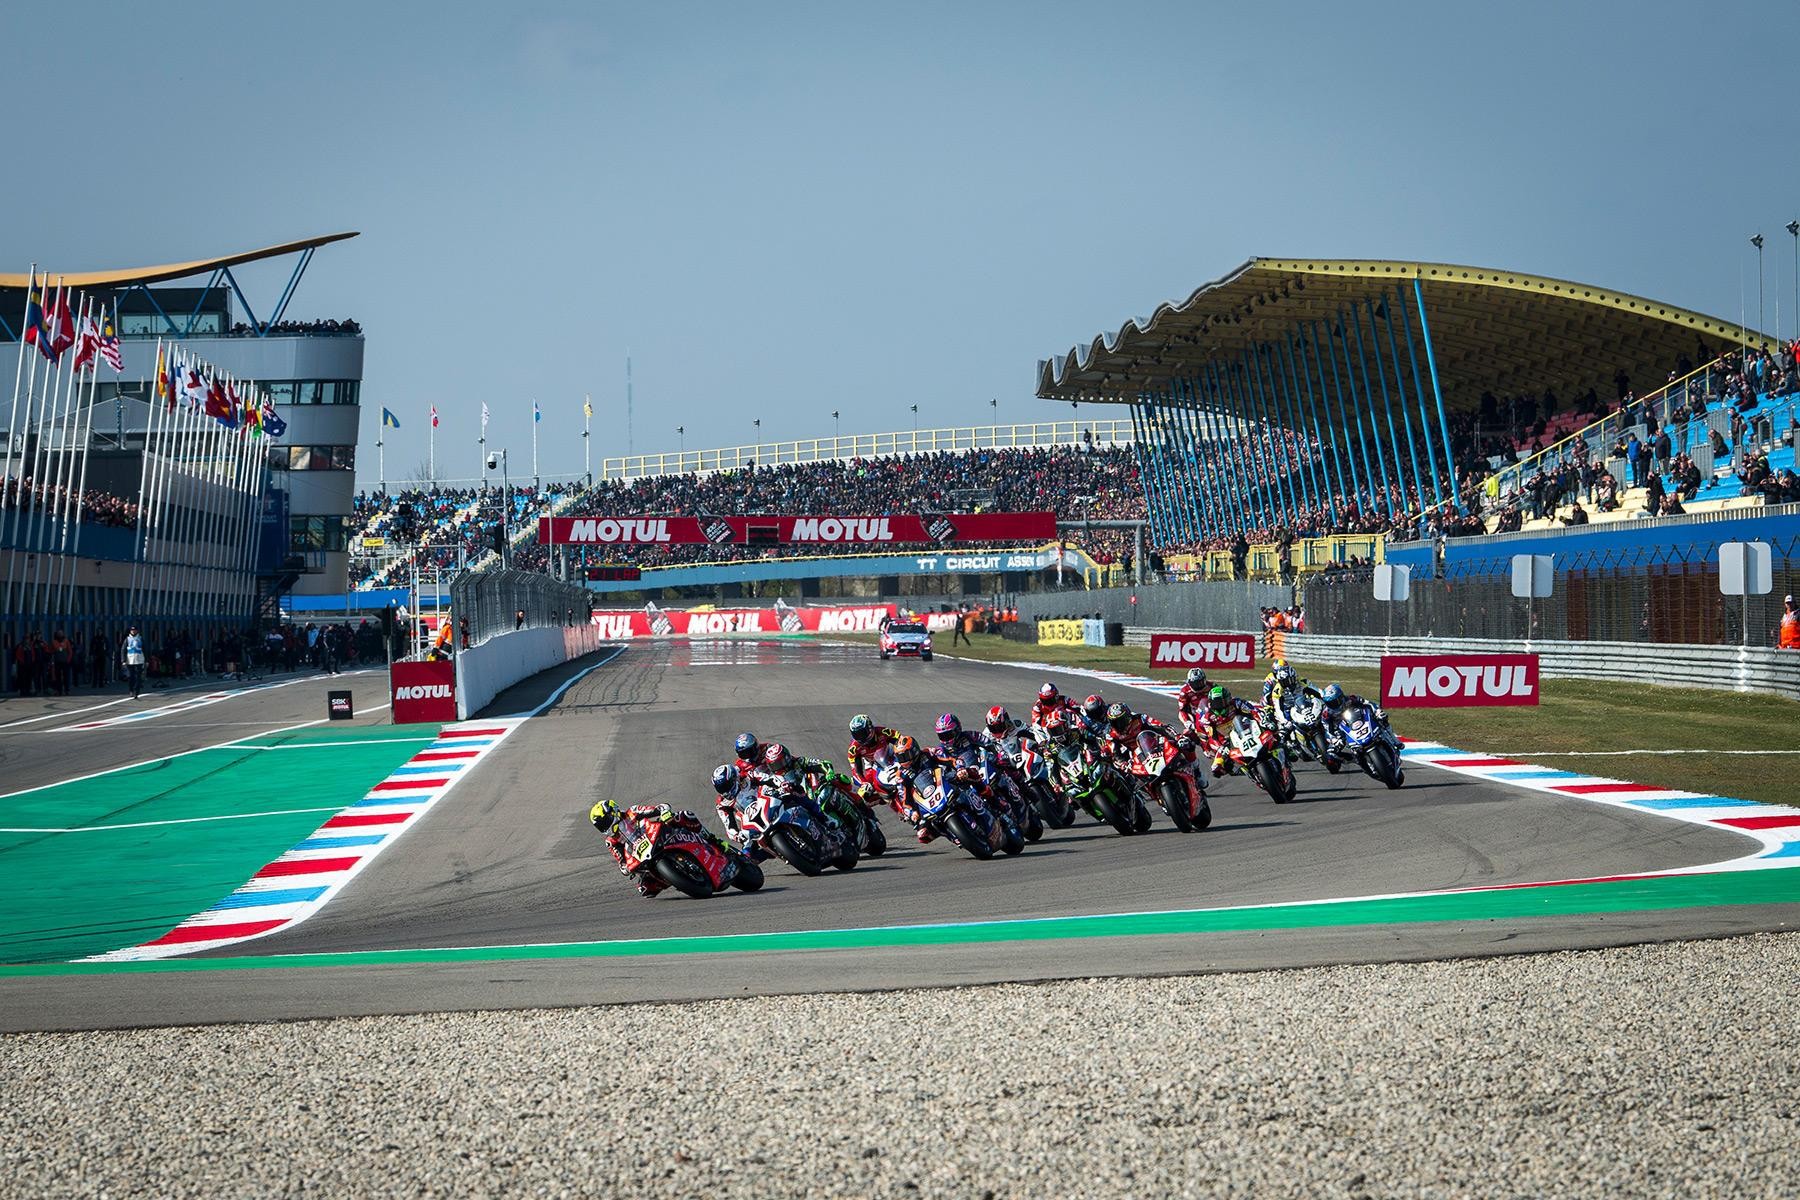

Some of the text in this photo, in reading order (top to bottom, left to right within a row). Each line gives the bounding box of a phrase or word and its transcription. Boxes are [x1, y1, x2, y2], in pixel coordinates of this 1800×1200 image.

[569, 519, 671, 541] MOTUL
[791, 518, 893, 541] MOTUL
[917, 558, 937, 570] TT
[946, 556, 1001, 570] CIRCUIT
[590, 614, 634, 640] TUL
[687, 613, 763, 634] MOTUL
[1155, 641, 1251, 663] MOTUL
[1388, 665, 1533, 697] MOTUL
[396, 684, 452, 700] MOTUL
[1242, 738, 1257, 752] 50
[1148, 760, 1159, 772] 7
